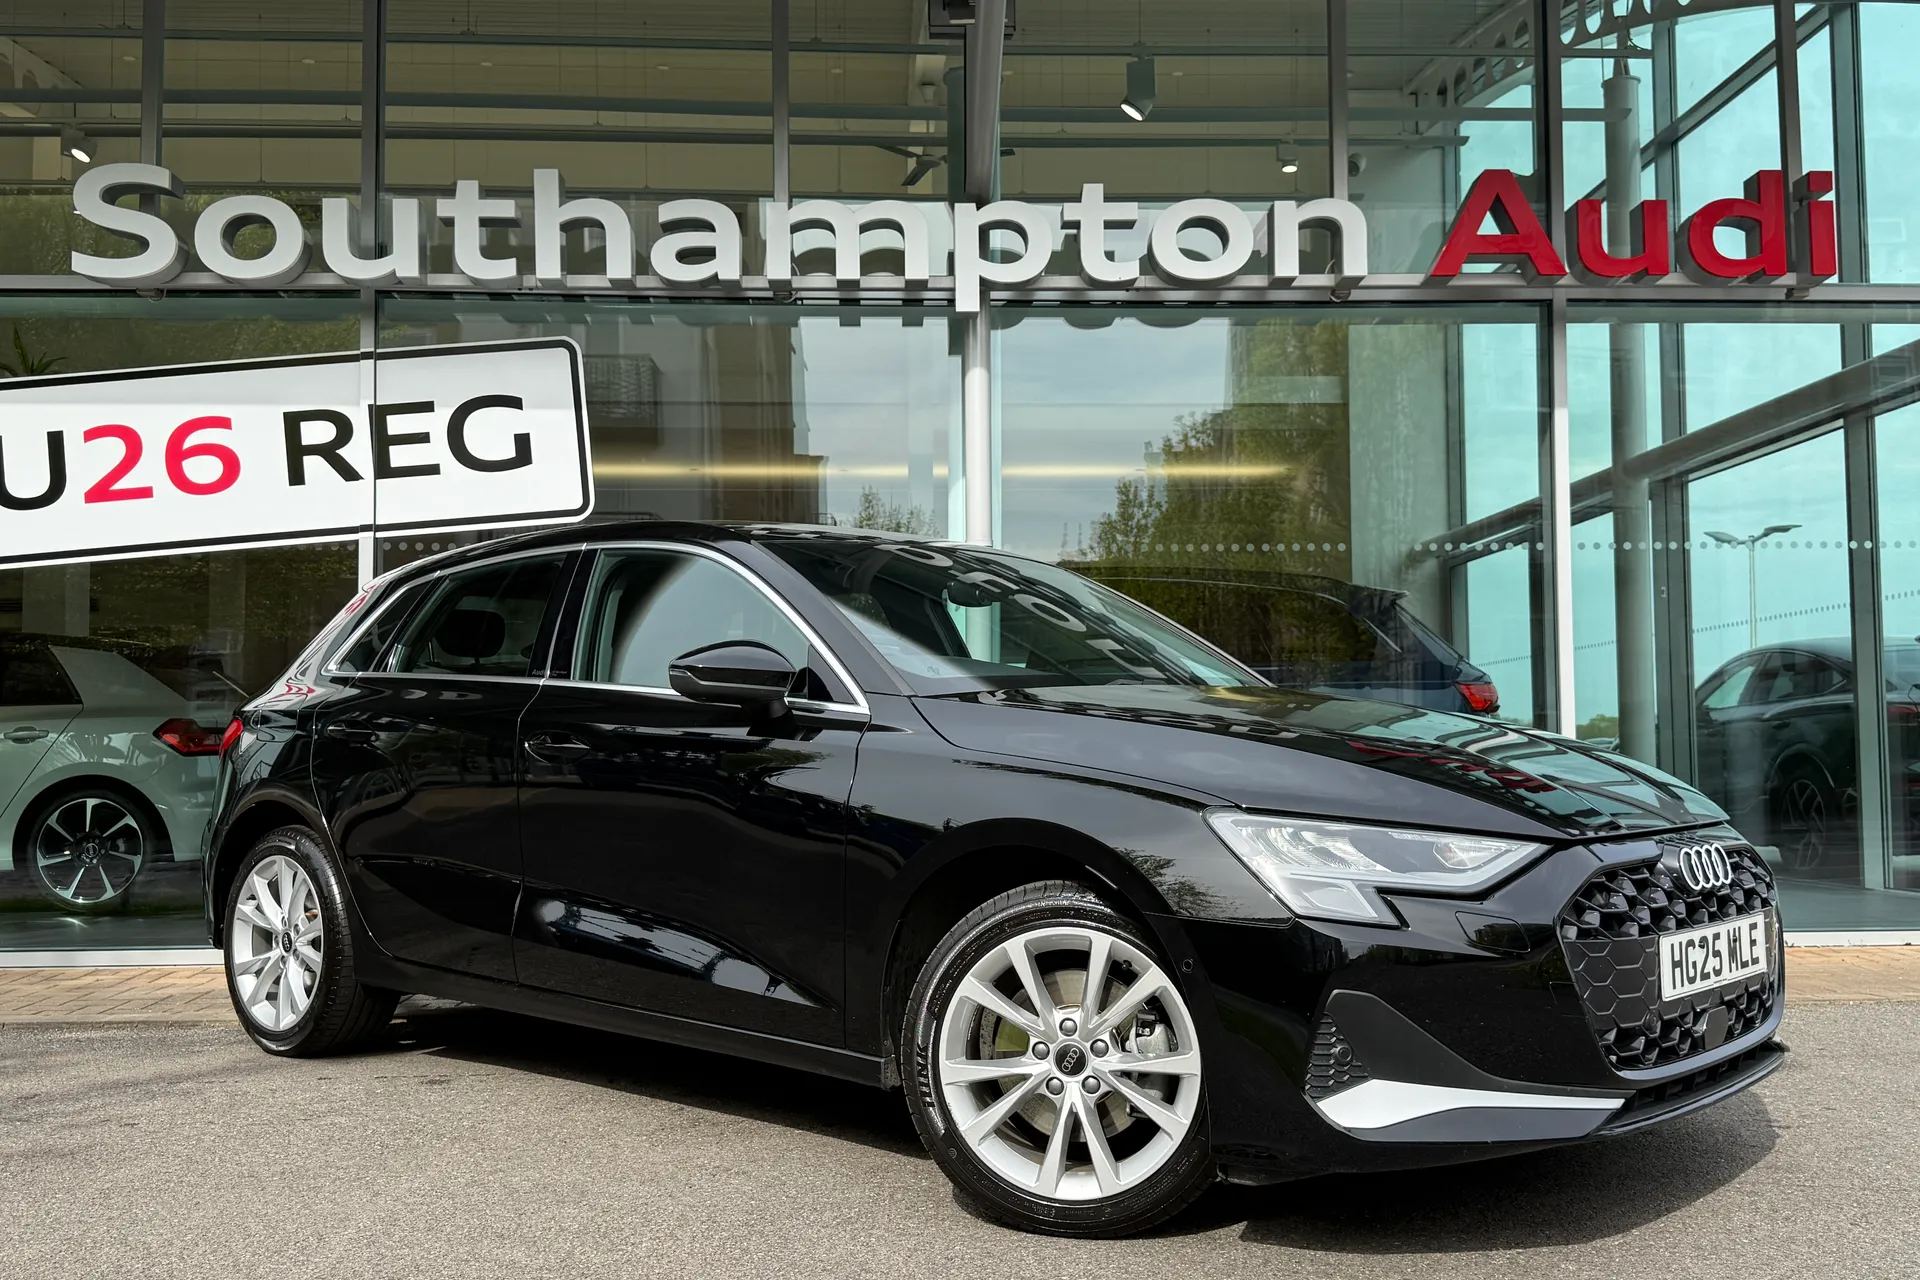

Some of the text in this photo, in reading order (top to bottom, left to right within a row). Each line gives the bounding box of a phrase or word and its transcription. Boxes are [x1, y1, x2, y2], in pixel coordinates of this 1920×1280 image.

[71, 163, 1838, 312] Southampton Audi
[0, 394, 533, 511] U26 REG
[1670, 921, 1760, 990] HG25 MLE
